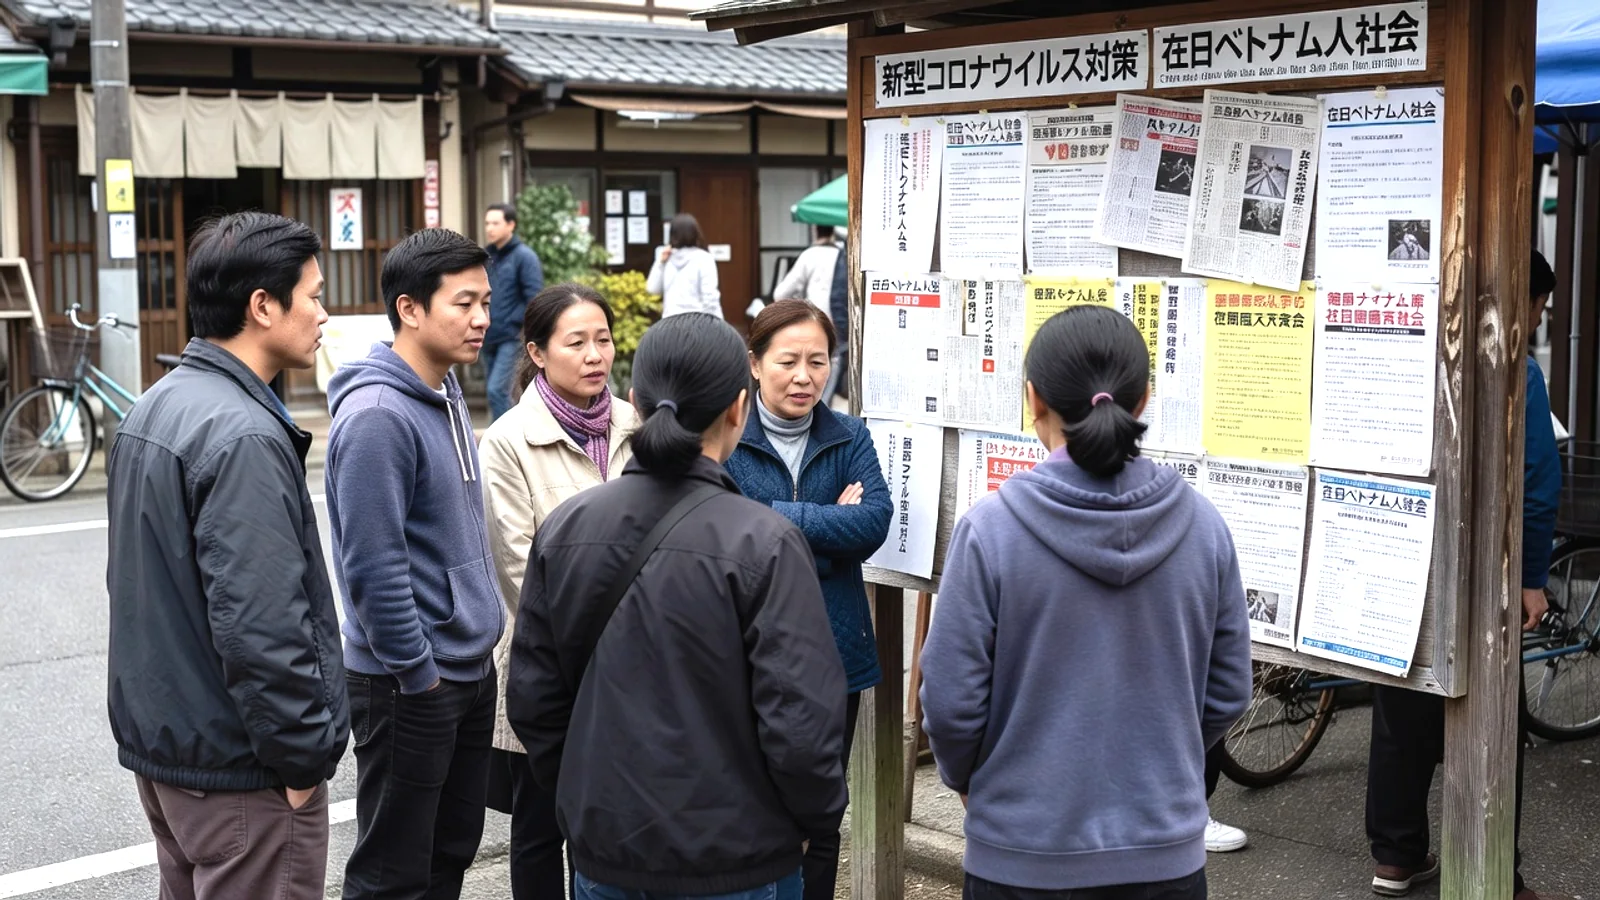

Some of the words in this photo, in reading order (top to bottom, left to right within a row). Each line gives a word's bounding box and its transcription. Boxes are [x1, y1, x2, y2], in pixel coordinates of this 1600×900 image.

[881, 40, 1140, 99] 新型コロナウイルス対策
[1161, 10, 1420, 72] 在日ベトナム人社会
[1327, 100, 1436, 122] 在日ベトナム人社会
